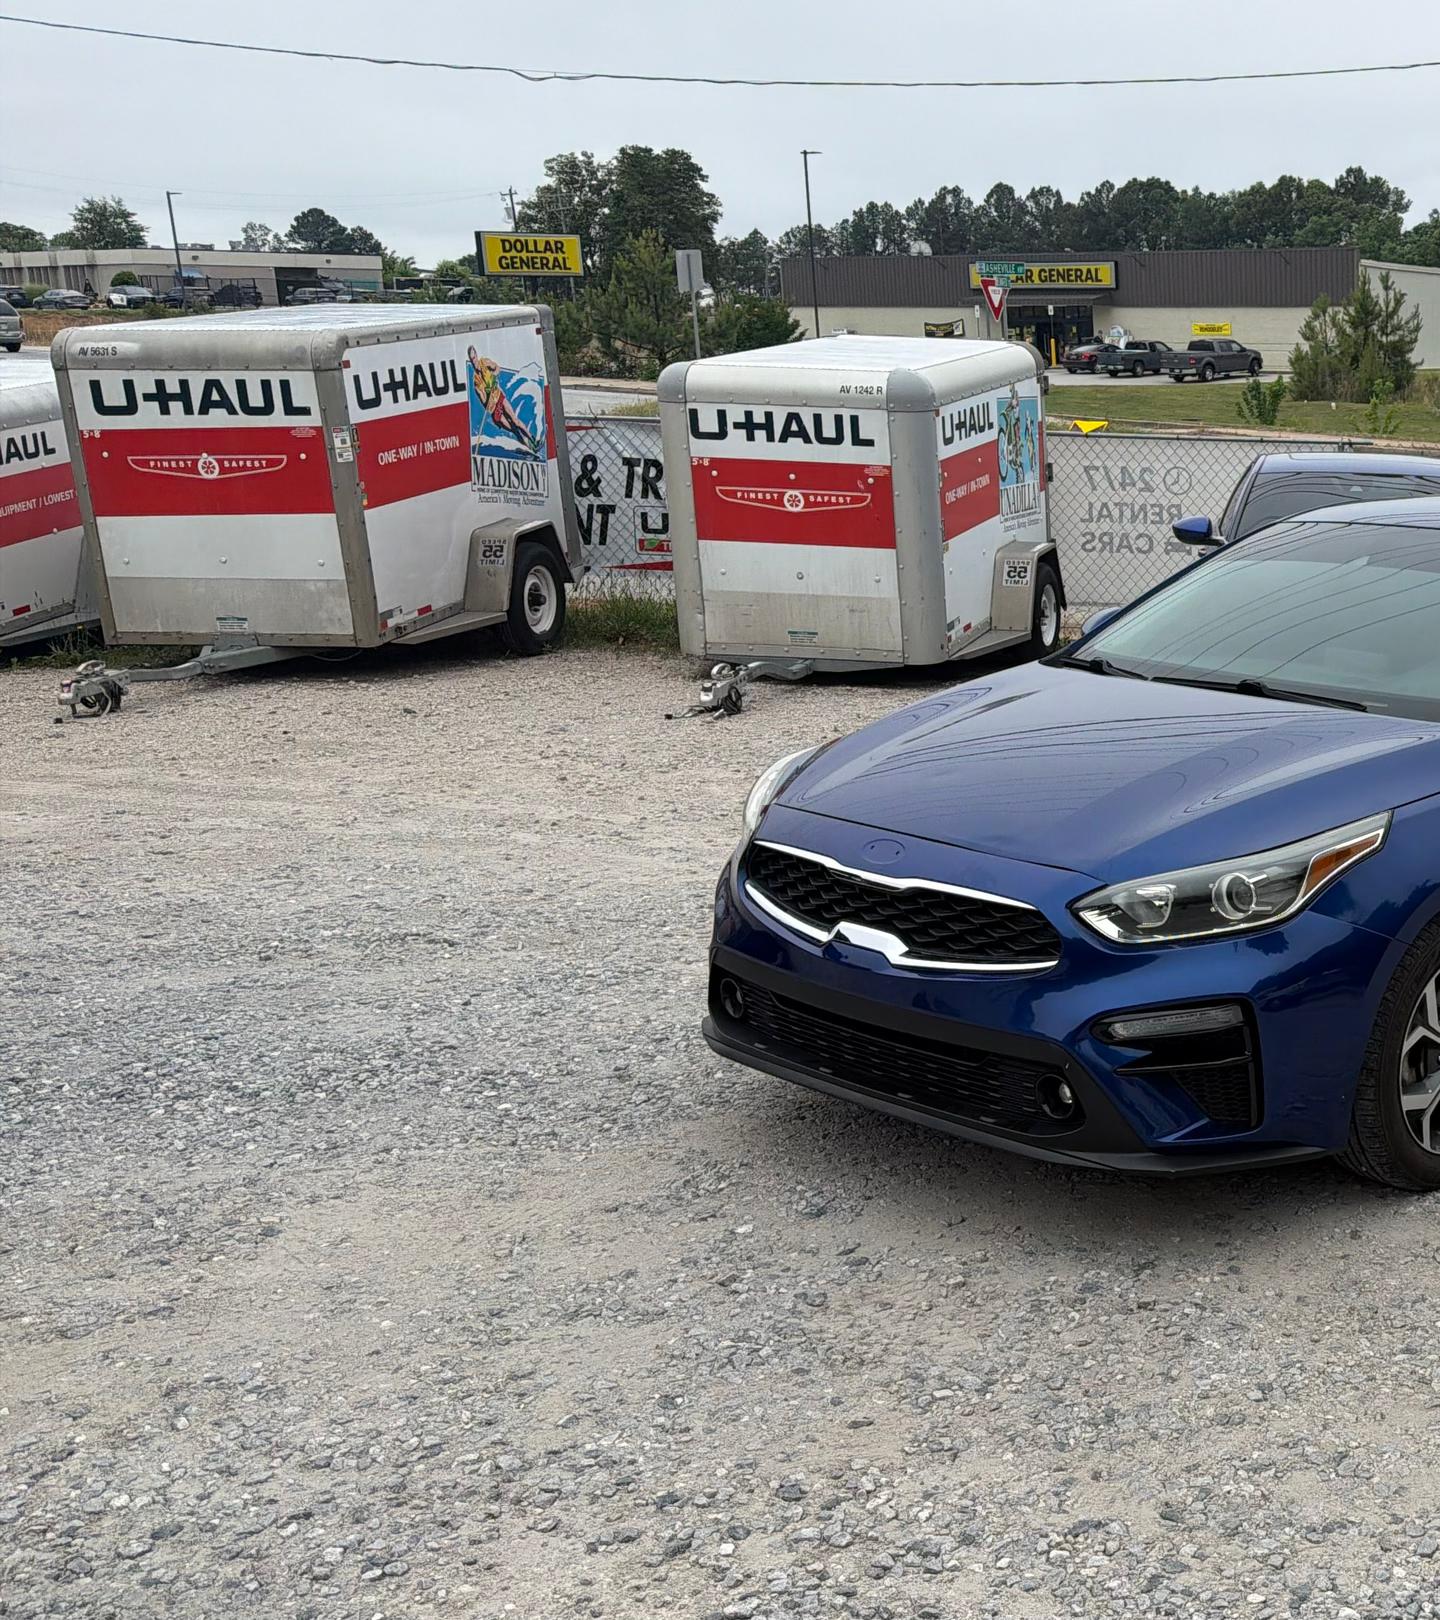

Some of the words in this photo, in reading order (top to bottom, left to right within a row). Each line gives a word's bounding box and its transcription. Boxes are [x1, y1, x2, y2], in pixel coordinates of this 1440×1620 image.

[500, 239, 565, 254] DOLLAR
[498, 256, 571, 270] GENERAL
[986, 263, 1015, 273] ASHEVILLE
[1038, 268, 1103, 283] GENERAL
[78, 346, 89, 356] AV
[90, 346, 109, 356] 5631
[111, 346, 117, 356] S
[353, 359, 466, 410] U-HAUL
[839, 385, 851, 394] AV
[854, 386, 874, 395] 1242
[876, 386, 883, 395] R
[89, 378, 312, 416] U-HAUL
[688, 408, 875, 447] U-HAUL
[942, 402, 994, 446] U-HAUL
[378, 444, 417, 465] ONE-WAY
[424, 435, 460, 454] IN-TOWN
[150, 460, 192, 468] FINEST
[223, 460, 267, 468] SAFEST
[472, 456, 541, 491] MADISON
[575, 454, 602, 497] &
[44, 489, 74, 506] LOWEST
[737, 492, 778, 500] FINEST
[809, 495, 852, 504] SAFEST
[945, 484, 967, 504] ONE-WAY
[970, 473, 990, 493] IN-TOWN
[1000, 482, 1038, 517] UNADILLA
